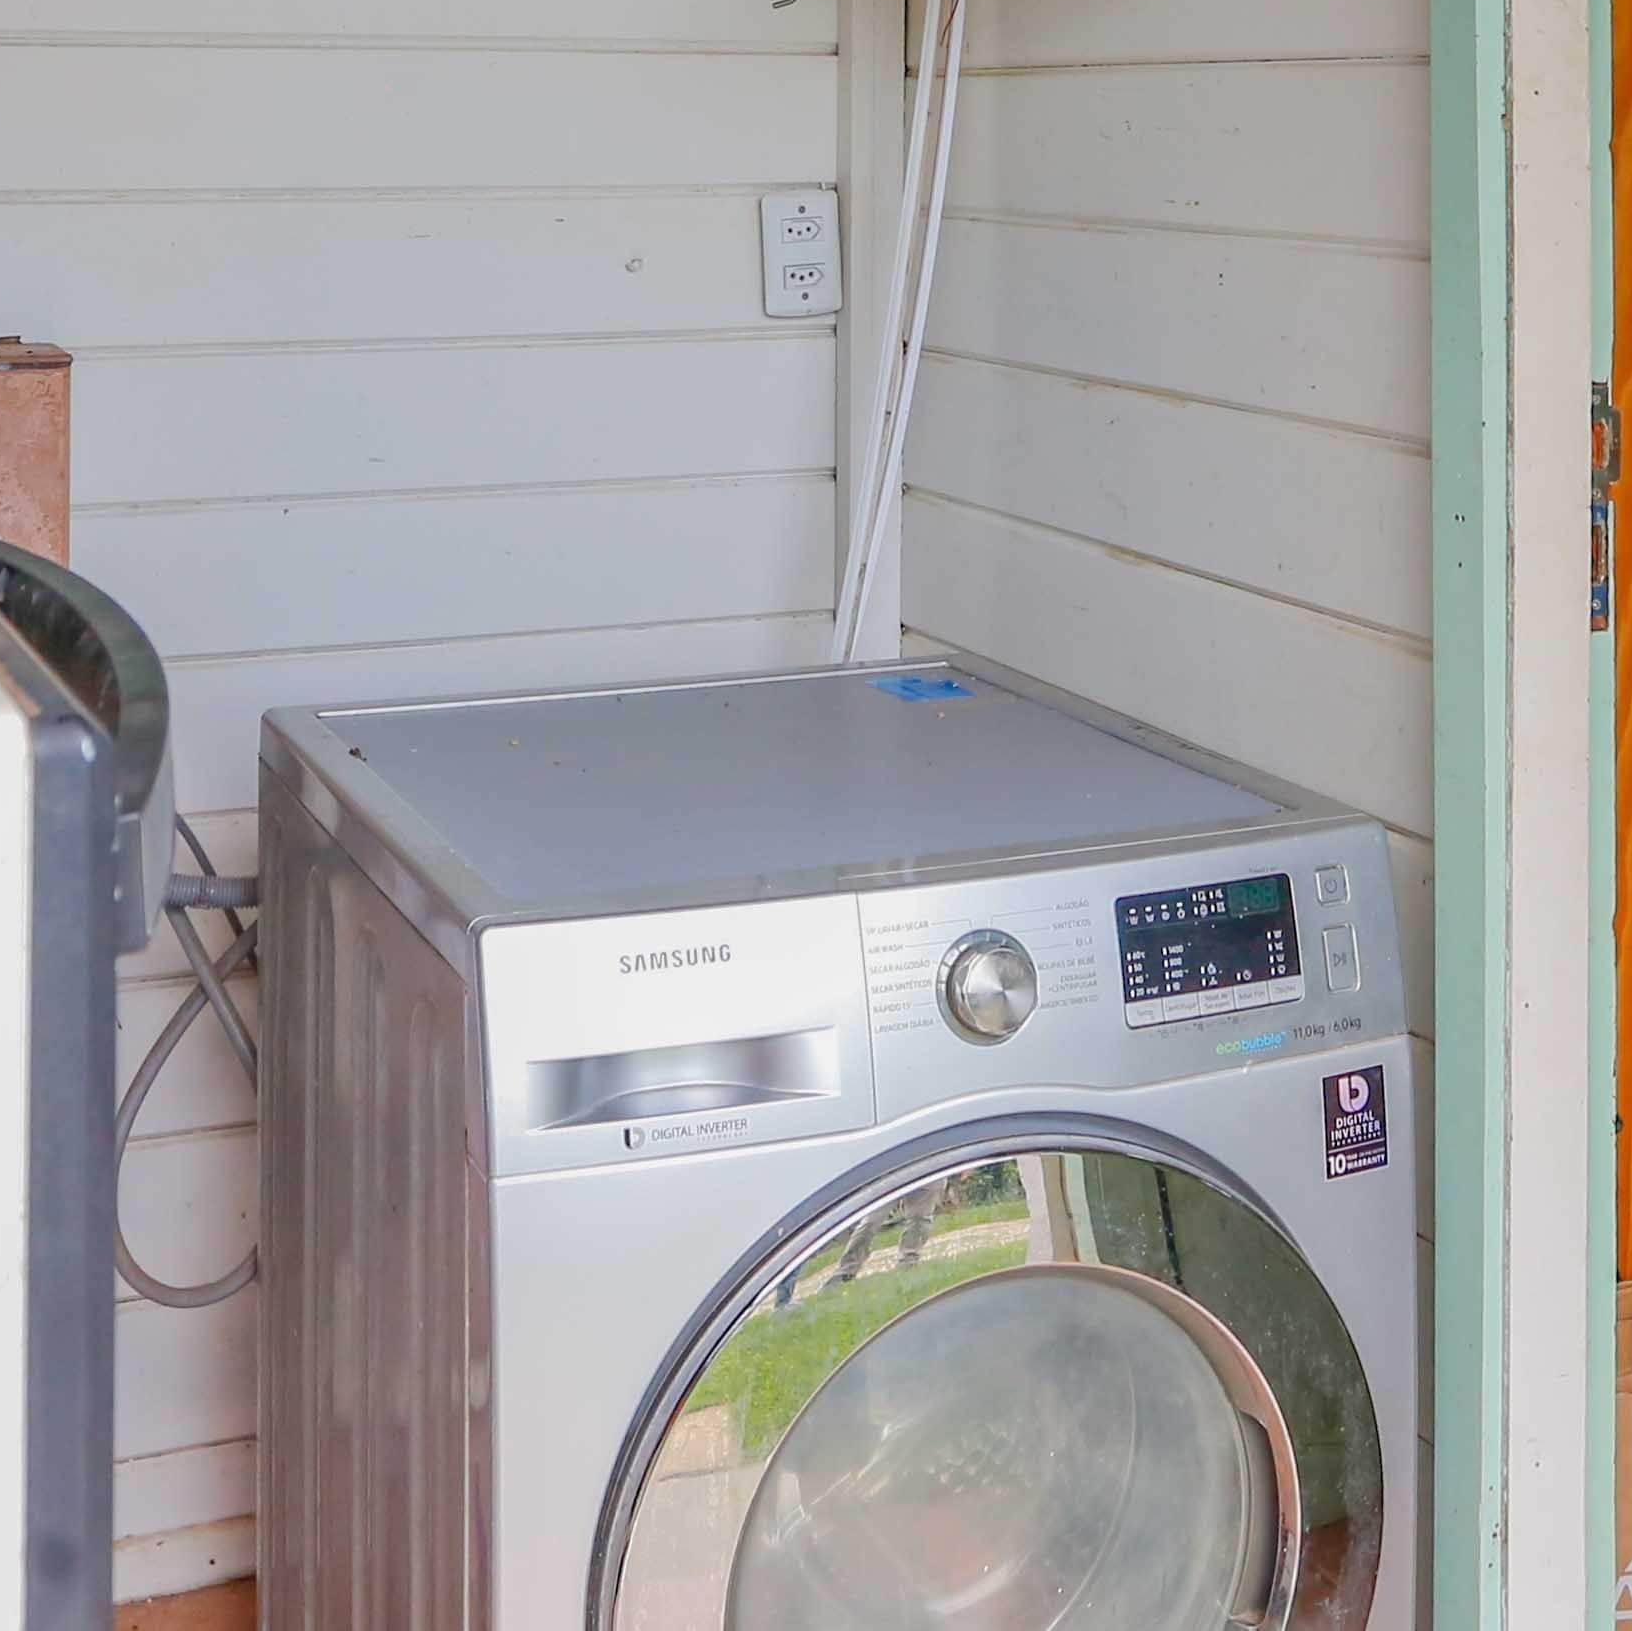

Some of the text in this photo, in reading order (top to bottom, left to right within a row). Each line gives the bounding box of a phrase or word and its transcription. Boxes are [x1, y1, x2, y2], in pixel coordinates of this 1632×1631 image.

[619, 943, 732, 975] SAMSUNG
[1216, 1033, 1282, 1055] ecobubble
[651, 1125, 694, 1142] DIGITAL
[696, 1118, 748, 1136] INVERTER
[1331, 1120, 1380, 1141] INVERTER
[1336, 1110, 1374, 1129] DIGITAL
[1328, 1153, 1346, 1176] 10
